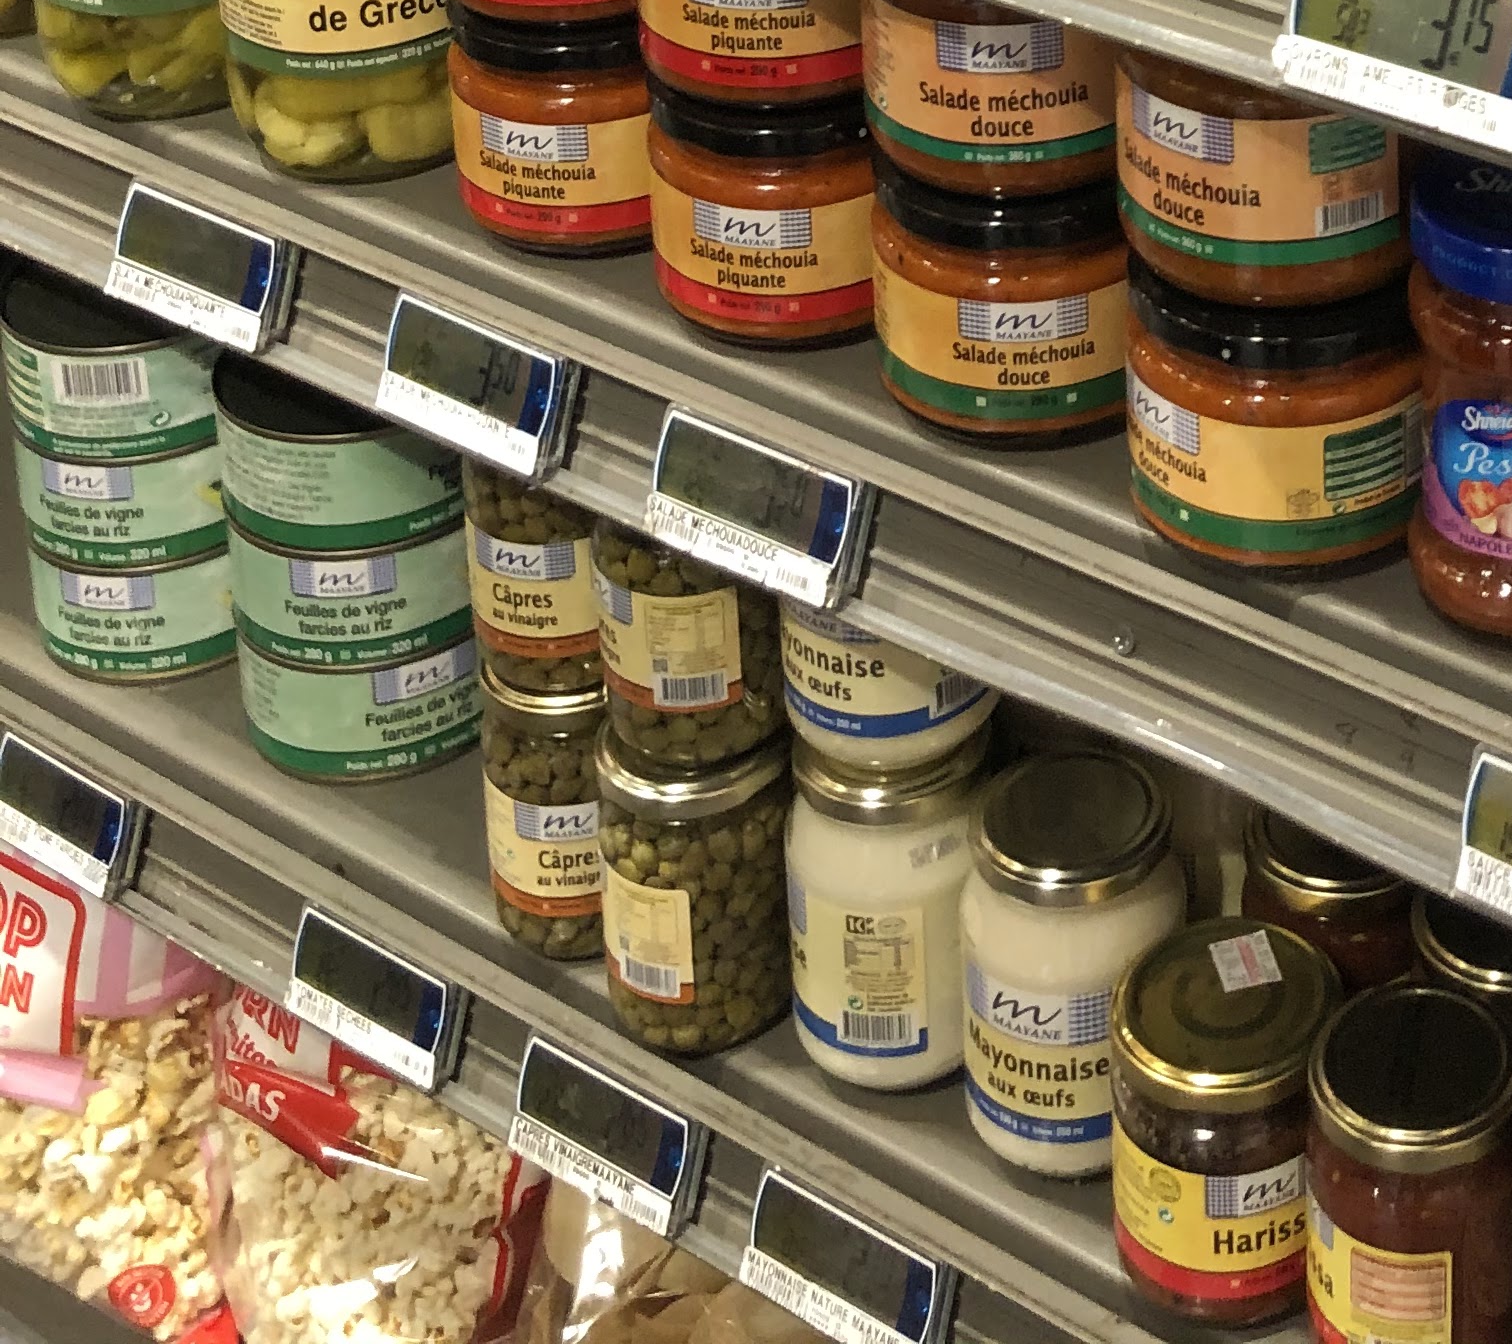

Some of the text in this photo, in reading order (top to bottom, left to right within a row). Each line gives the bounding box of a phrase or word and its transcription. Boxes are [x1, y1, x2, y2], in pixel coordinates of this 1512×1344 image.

[309, 4, 347, 31] de
[682, 4, 815, 30] Salade méchouia
[710, 33, 782, 52] piquante
[919, 82, 1089, 113] Salade méchouia
[970, 114, 1033, 137] douce
[480, 151, 595, 182] Salade méchouia
[502, 180, 565, 200] piquante
[1165, 172, 1261, 208] méchouia
[1153, 189, 1205, 227] douce
[690, 239, 818, 270] Salade méchouia
[717, 267, 785, 289] piquante
[952, 339, 1095, 365] Salade méchouia
[997, 367, 1050, 386] douce
[84, 507, 101, 519] de
[105, 506, 143, 522] vigne
[650, 497, 687, 522] SALADE
[93, 526, 109, 536] au
[113, 524, 130, 537] riz
[341, 604, 360, 617] de
[364, 599, 406, 616] vigne
[493, 581, 552, 610] Câpres
[352, 622, 371, 633] au
[375, 617, 392, 632] riz
[508, 610, 558, 628] vinaigre
[808, 675, 851, 702] œufs
[993, 1014, 1061, 1039] MAAYANE
[969, 1019, 1109, 1081] Mayonnaise
[988, 1072, 1075, 1109] aux œufs
